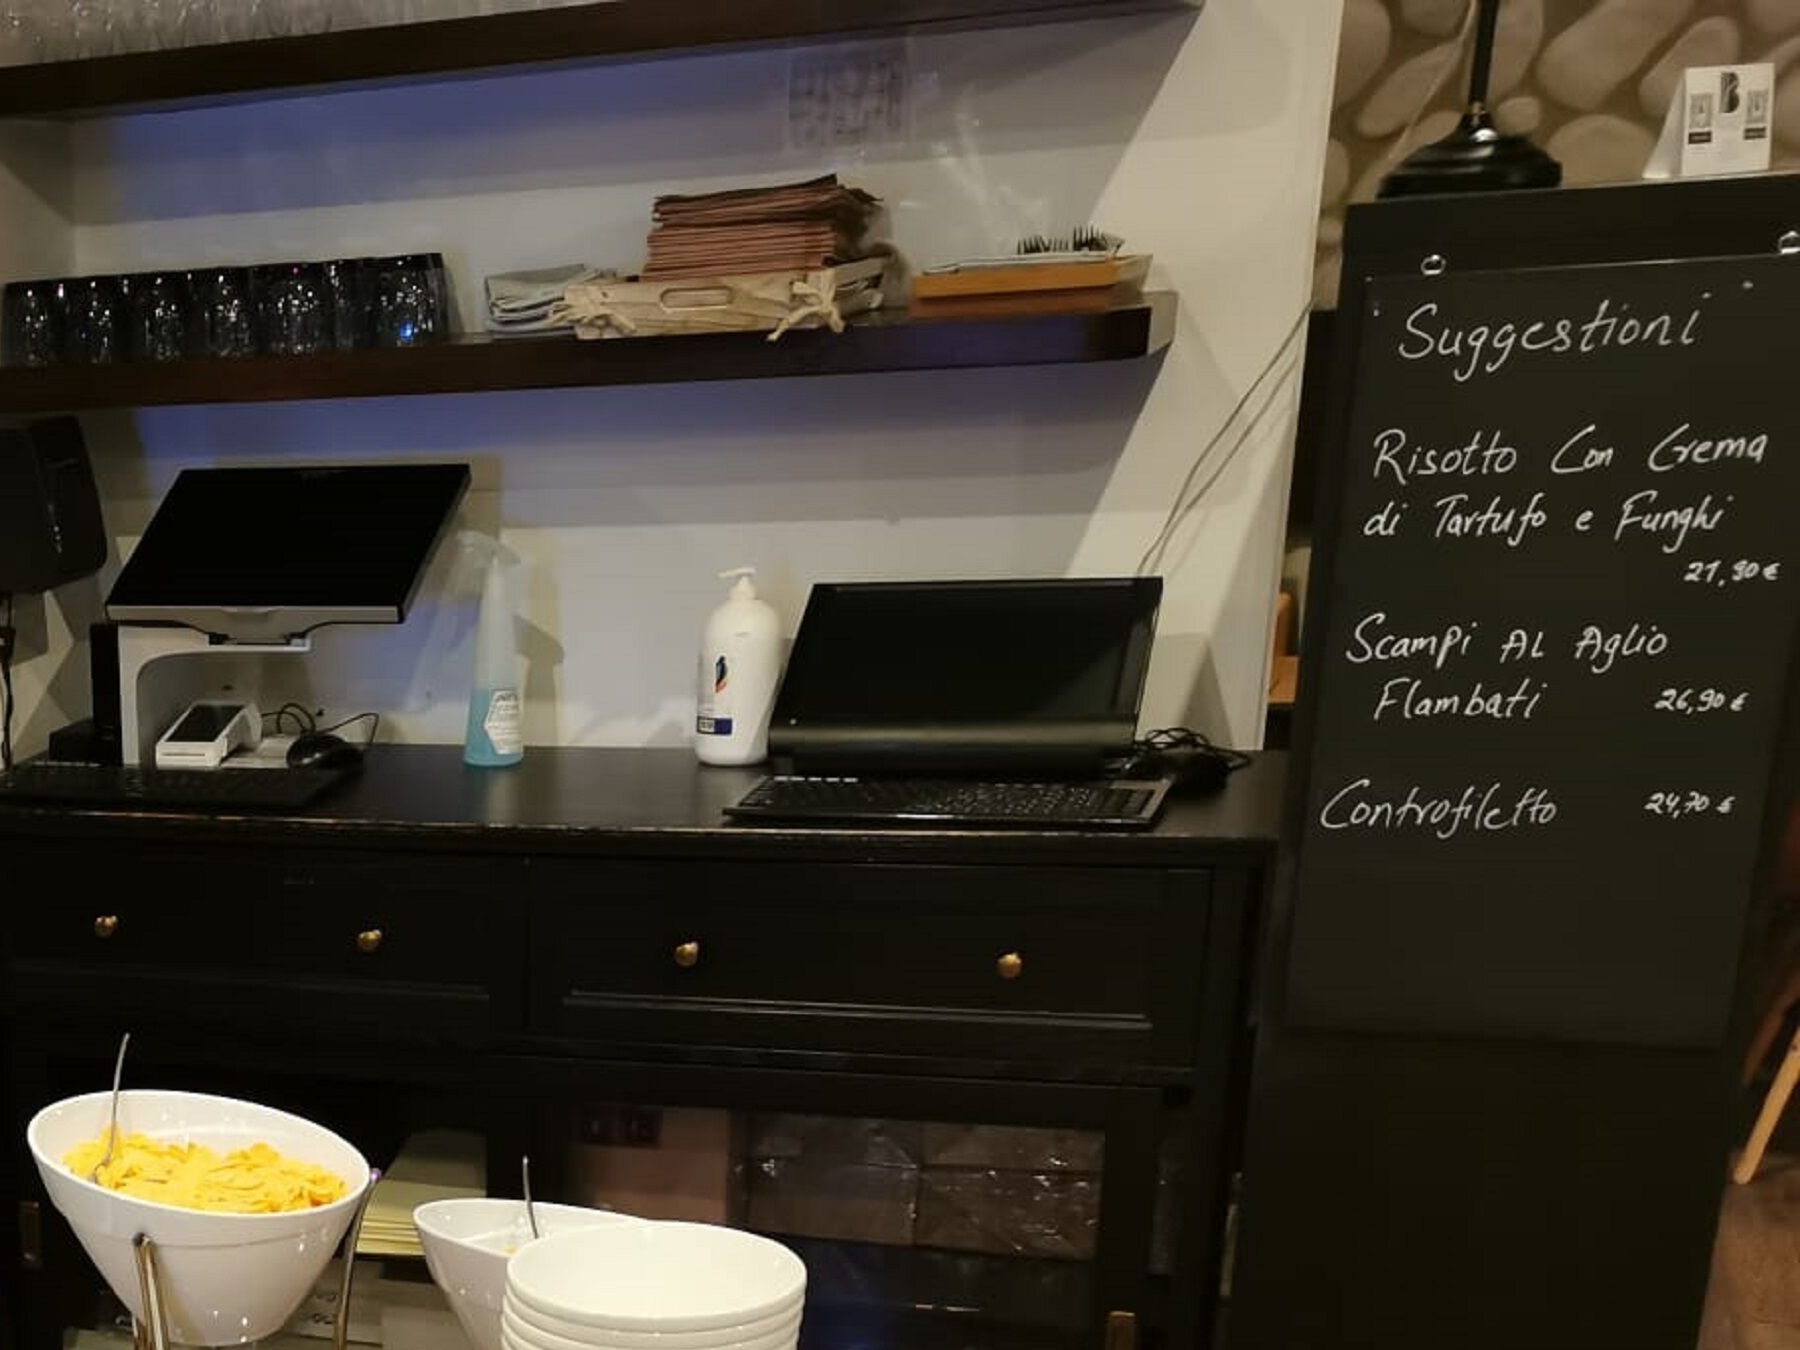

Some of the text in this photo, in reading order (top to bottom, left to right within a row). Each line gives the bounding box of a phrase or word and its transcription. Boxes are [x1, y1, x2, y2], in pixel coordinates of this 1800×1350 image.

[1398, 293, 1708, 382] Suggestioni
[1373, 424, 1768, 486] Risotto Con Crema
[1363, 490, 1734, 554] di Tartufo e Funghi
[1345, 612, 1478, 669] Scampi
[1574, 623, 1668, 674] Aglio
[1373, 676, 1548, 720] Flambati
[1320, 778, 1557, 839] Controfiletto
